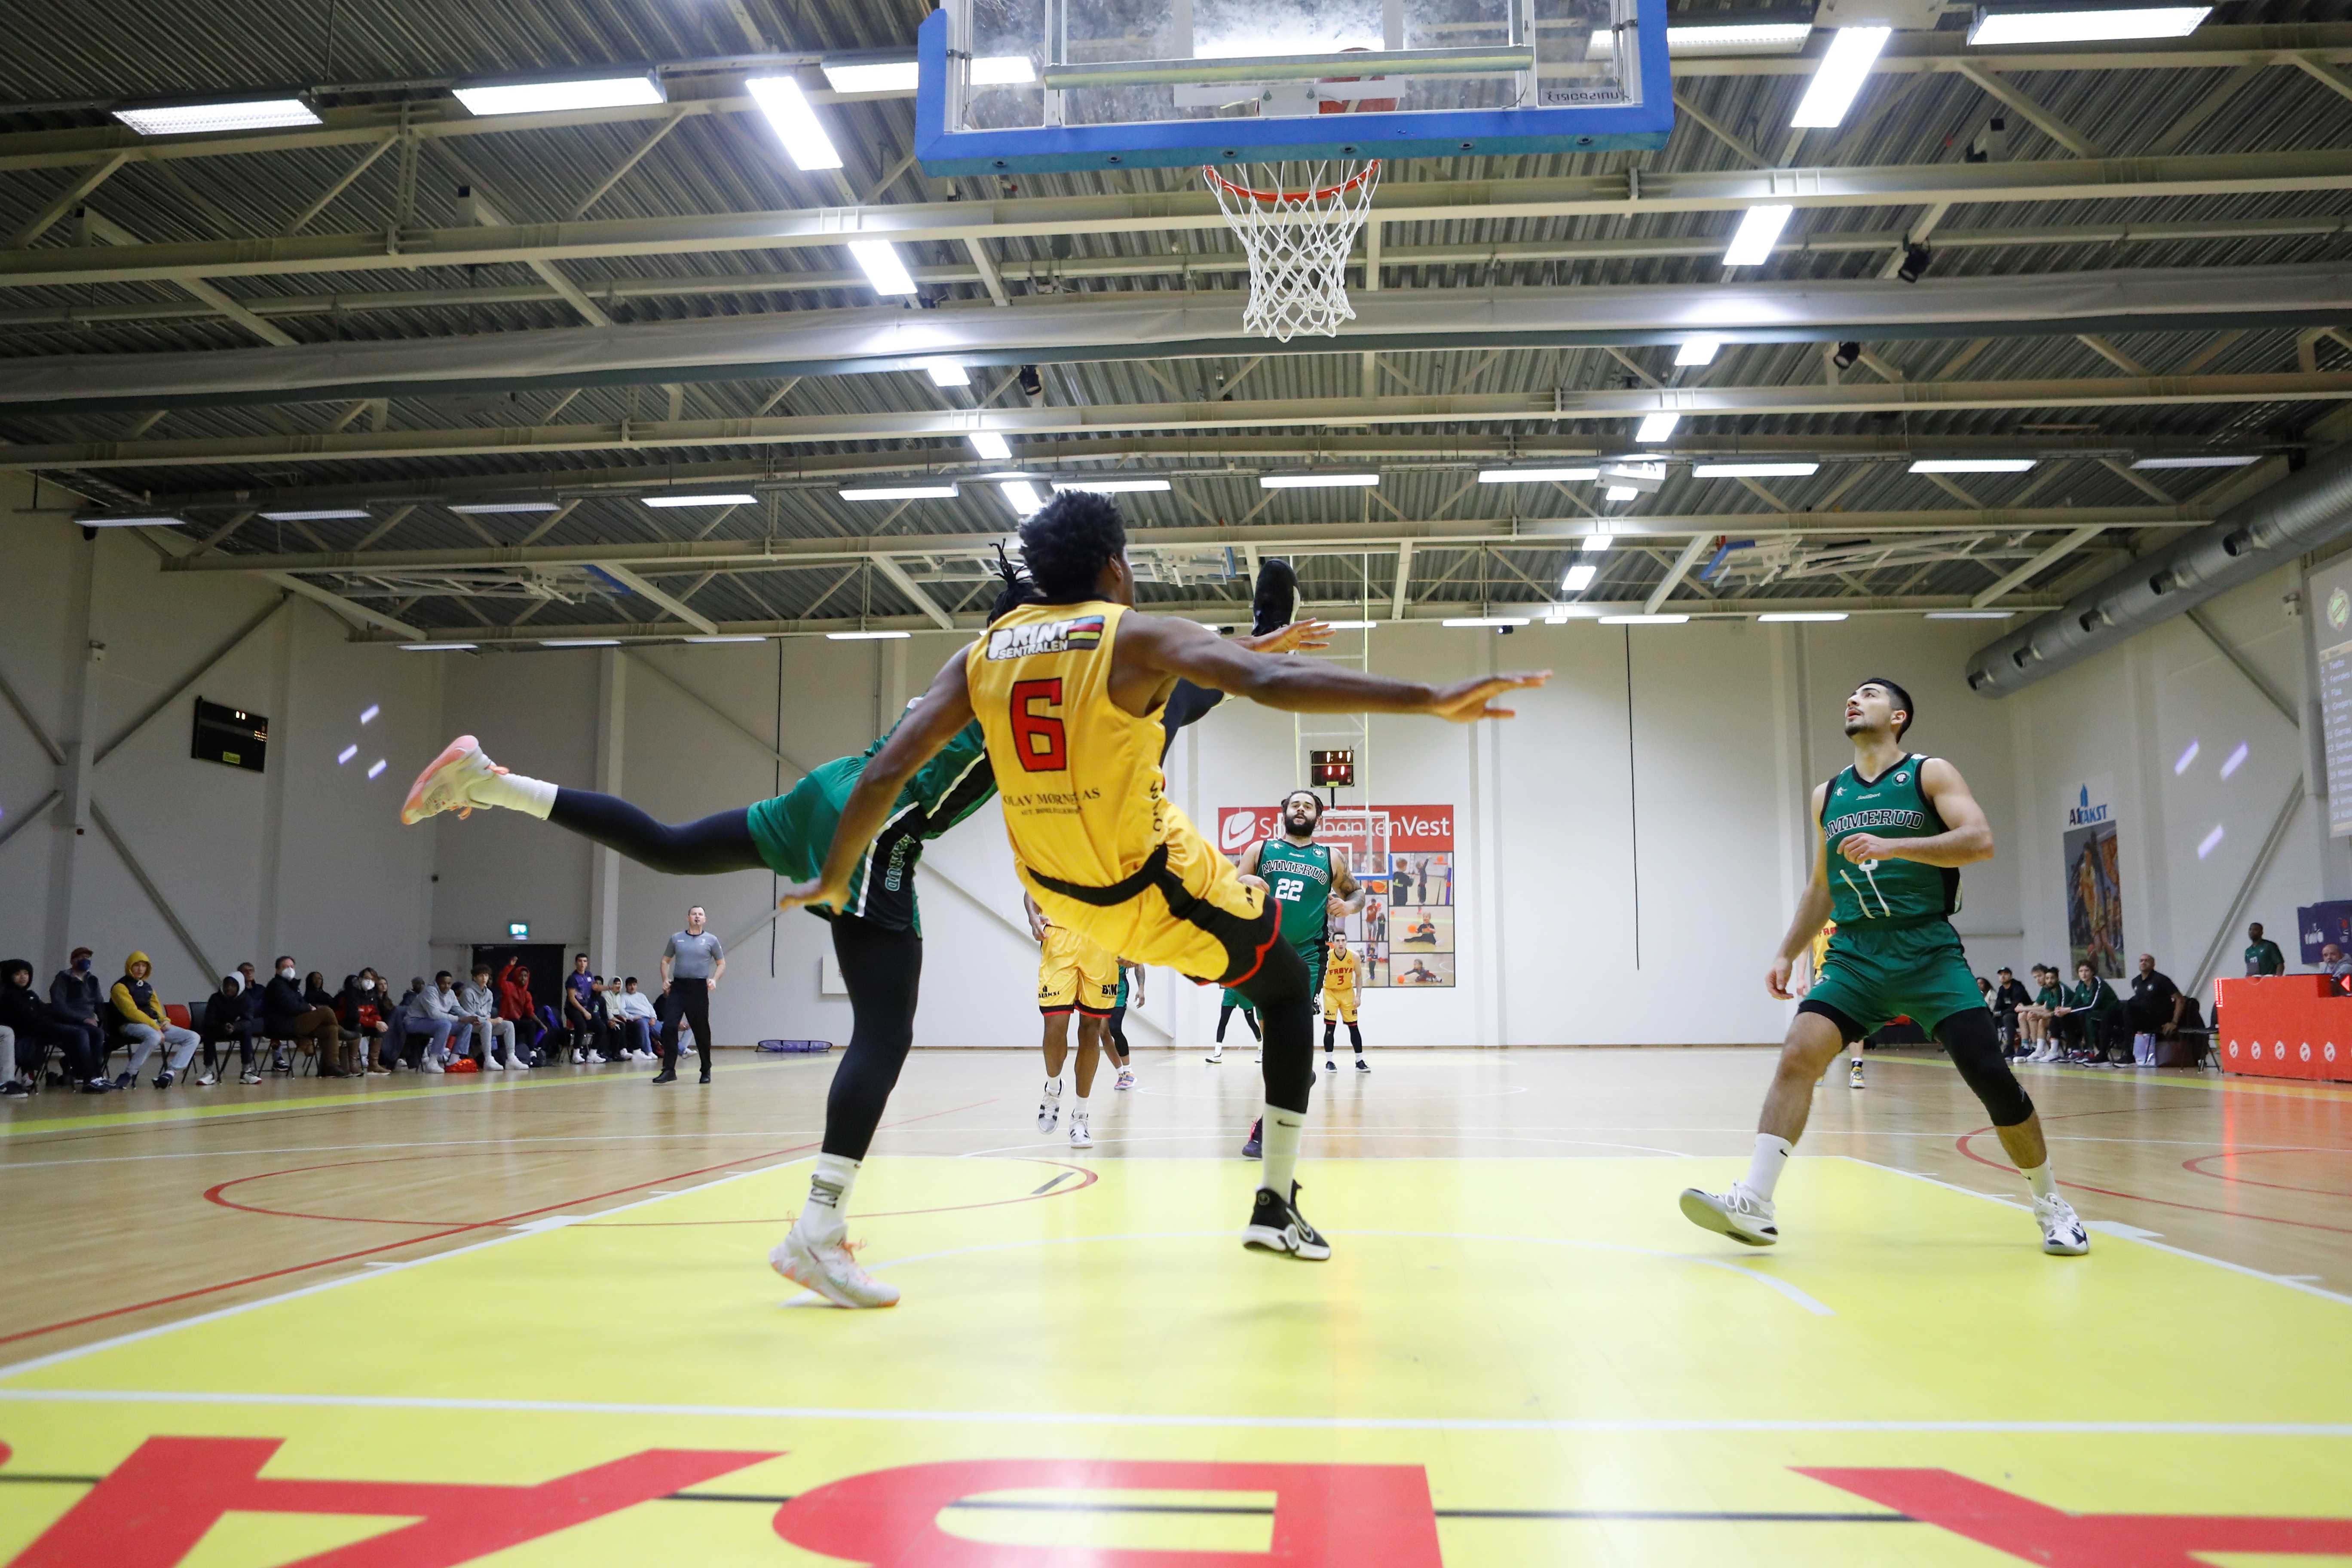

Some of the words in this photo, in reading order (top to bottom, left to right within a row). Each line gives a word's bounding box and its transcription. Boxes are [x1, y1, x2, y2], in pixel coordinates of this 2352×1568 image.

[987, 619, 1075, 660] PRINT
[998, 640, 1068, 659] SENTRALEN
[1010, 677, 1067, 772] 6
[1083, 787, 1101, 801] AS
[1262, 860, 1328, 885] AMMERUD
[1275, 878, 1304, 902] 22
[1329, 967, 1353, 975] FRØYA
[1337, 975, 1344, 986] 3
